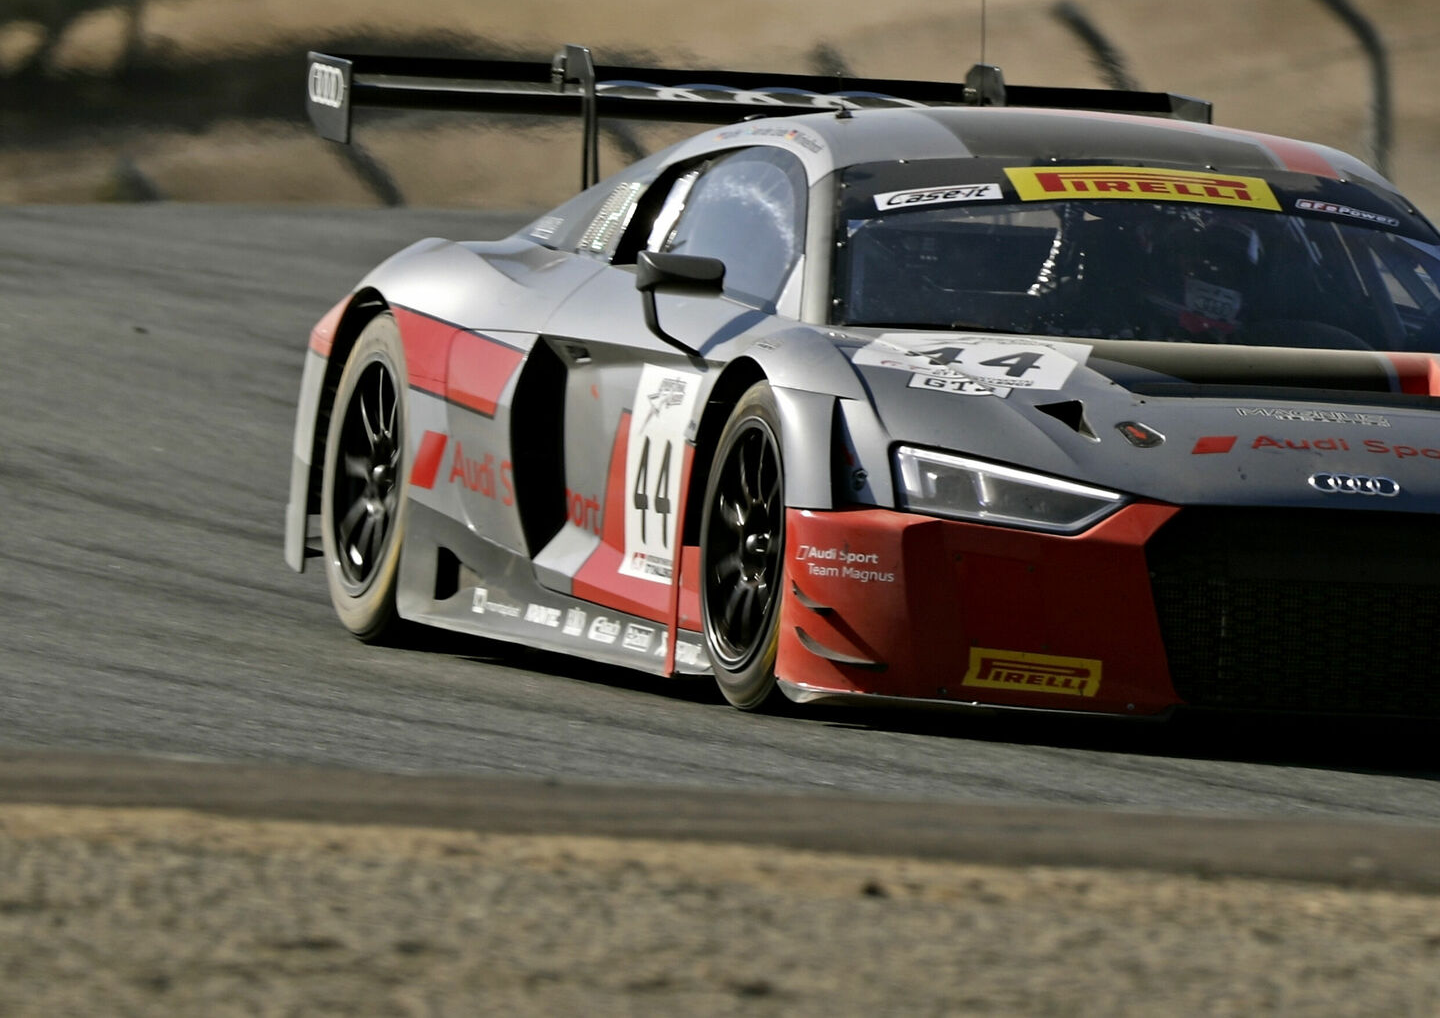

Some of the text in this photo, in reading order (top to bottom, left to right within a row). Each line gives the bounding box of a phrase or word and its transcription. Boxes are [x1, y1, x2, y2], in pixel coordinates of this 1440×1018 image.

[1034, 172, 1252, 201] PIRELLI
[904, 347, 1045, 378] 44
[1252, 435, 1349, 452] Audi
[449, 441, 496, 500] Audi
[634, 436, 672, 549] 44
[808, 547, 879, 564] Audi Sport
[807, 563, 895, 583] Team Magnus
[976, 657, 1091, 690] PIRELLI
